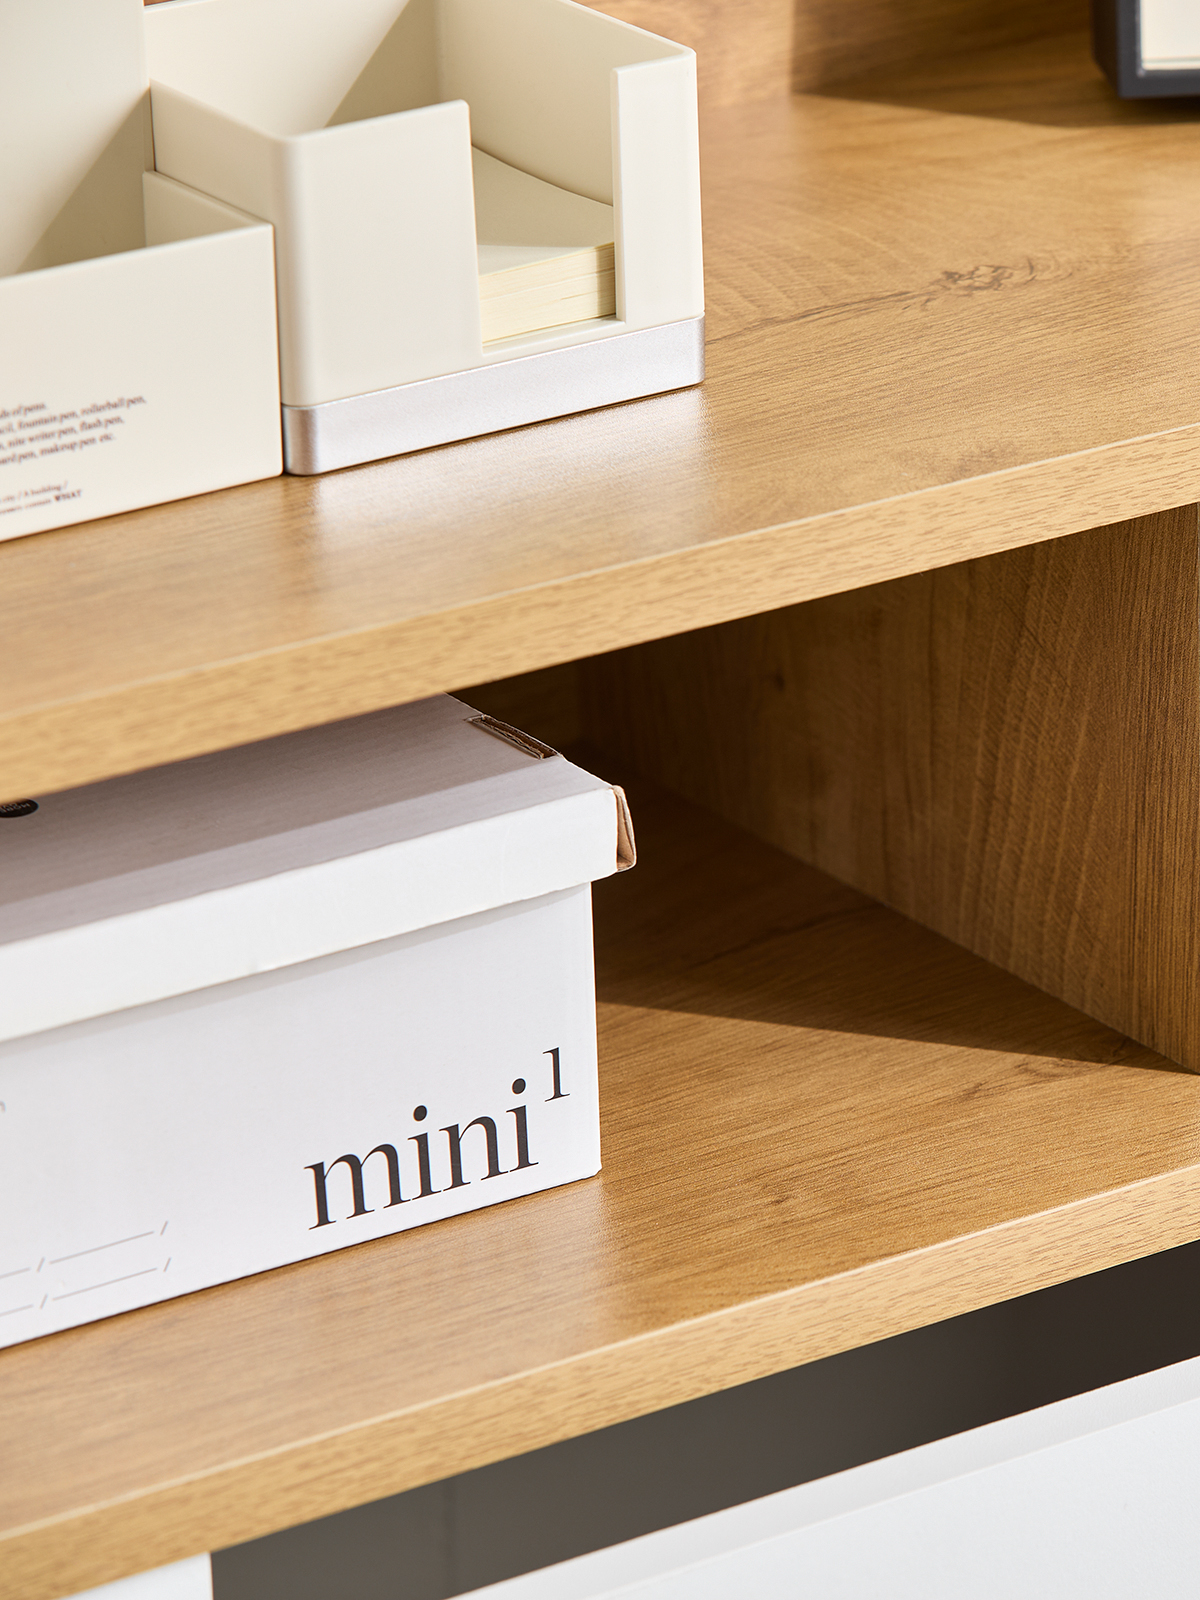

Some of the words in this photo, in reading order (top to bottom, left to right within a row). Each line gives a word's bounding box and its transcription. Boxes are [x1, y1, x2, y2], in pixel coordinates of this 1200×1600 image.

[17, 414, 58, 430] fountain
[59, 410, 78, 424] pen,
[80, 397, 125, 416] rollerball
[57, 426, 78, 439] pen,
[104, 416, 124, 430] pen,
